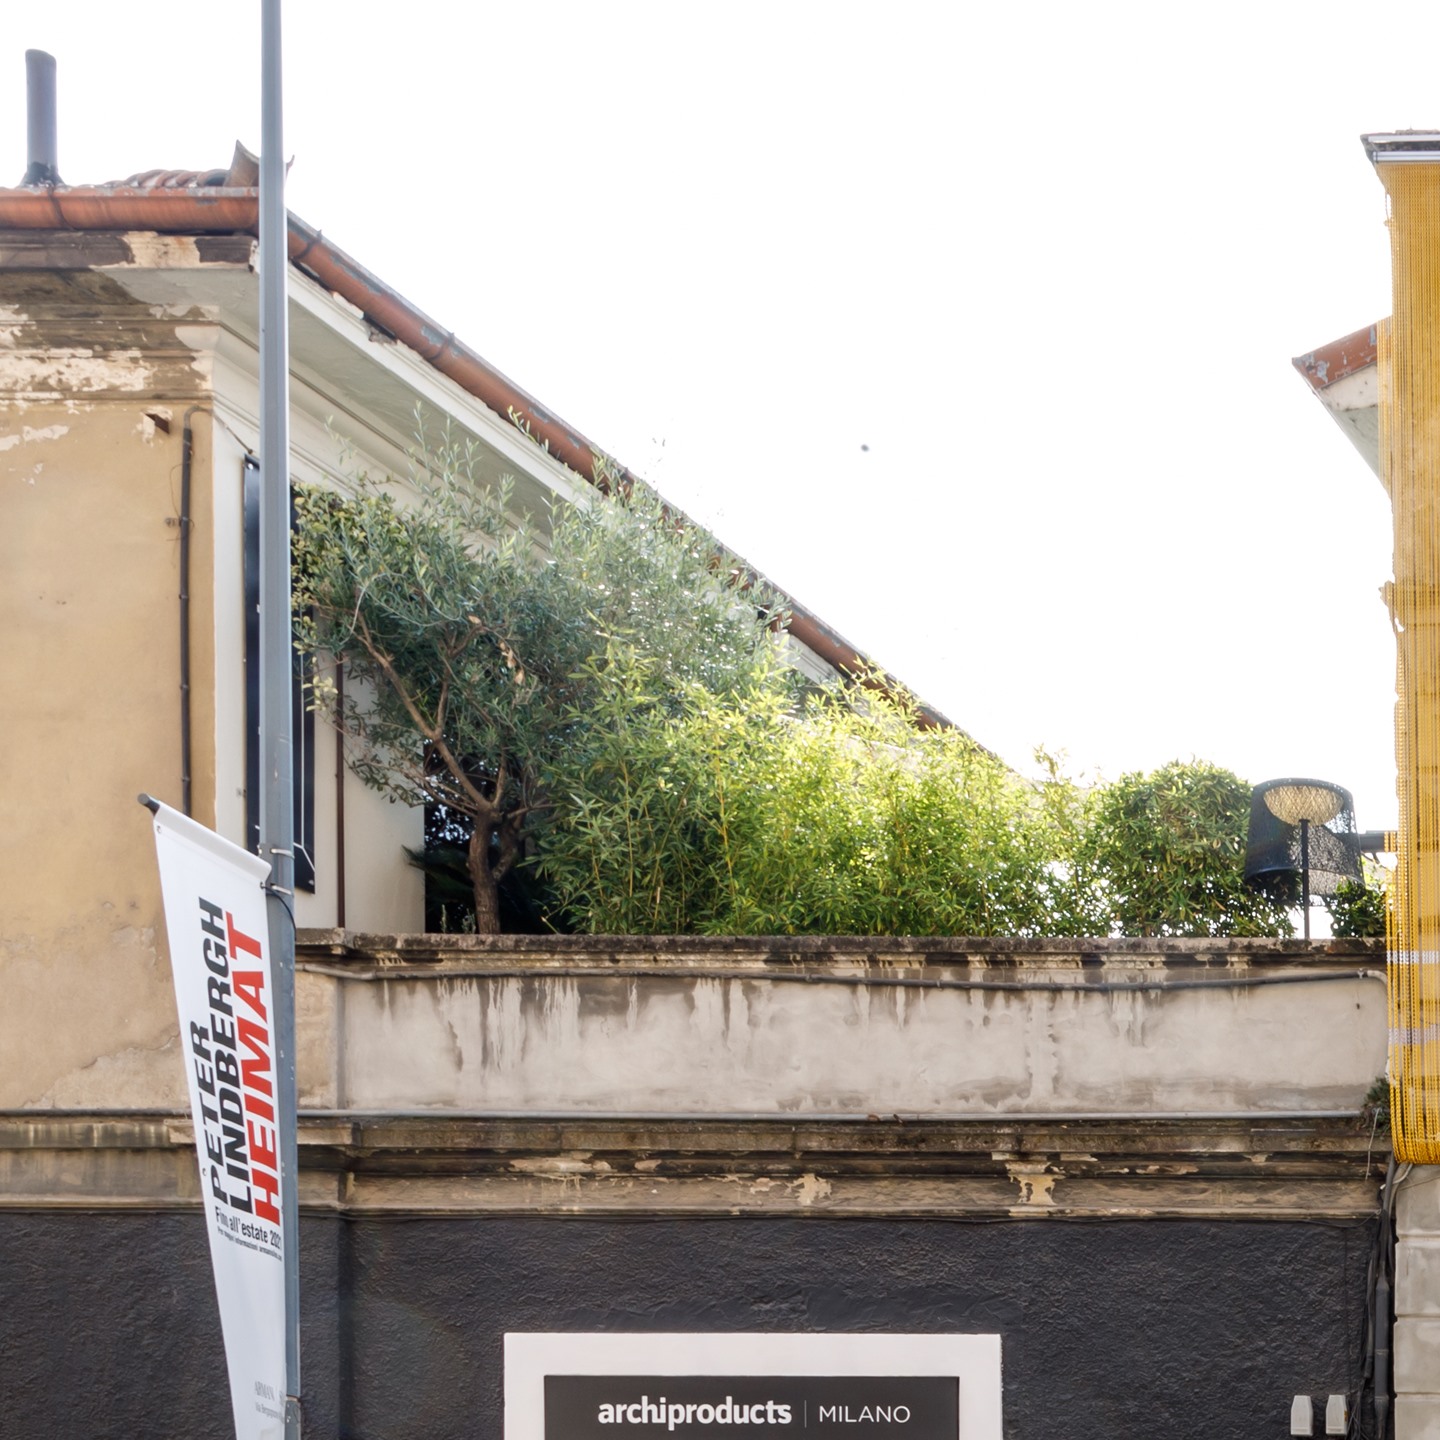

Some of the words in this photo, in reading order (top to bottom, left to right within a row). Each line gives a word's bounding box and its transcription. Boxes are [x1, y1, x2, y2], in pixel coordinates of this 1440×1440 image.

[190, 1019, 229, 1205] PETER
[198, 896, 254, 1215] LINDBERGH
[225, 911, 280, 1227] HEIMAT
[598, 1396, 792, 1431] archiproducts
[819, 1405, 911, 1423] MILANO
